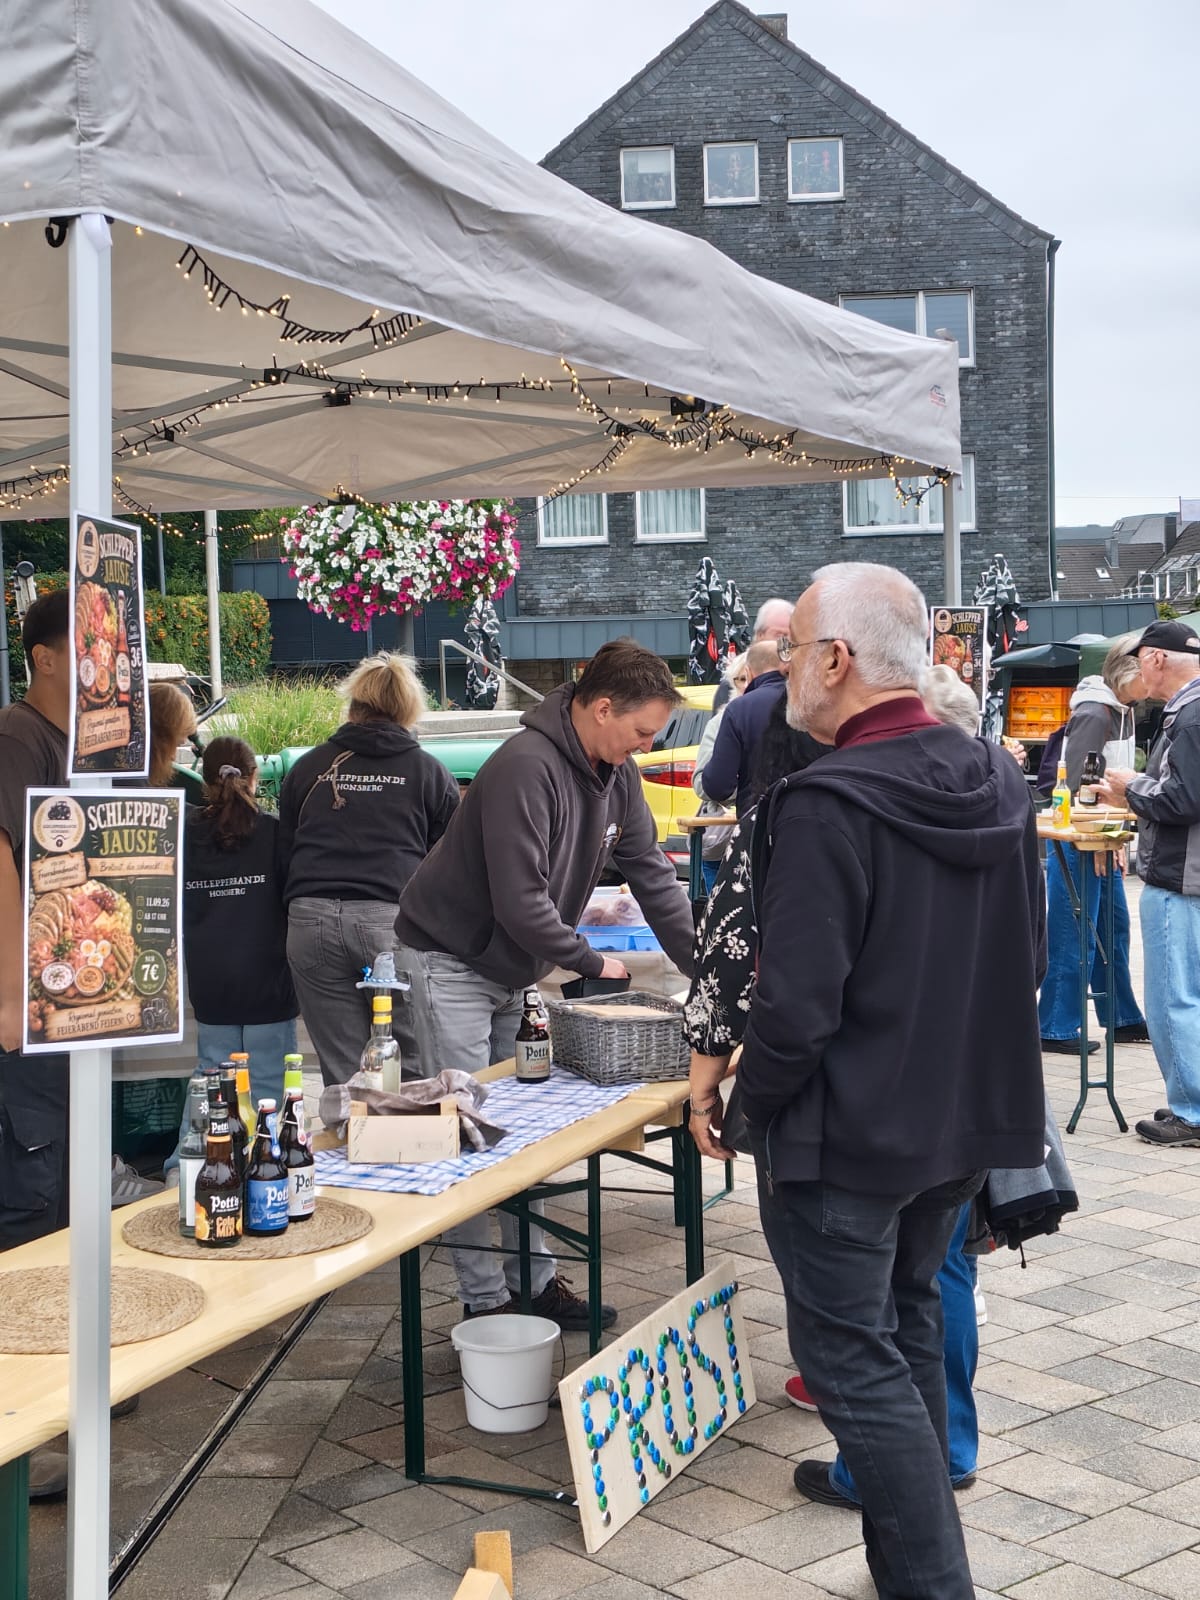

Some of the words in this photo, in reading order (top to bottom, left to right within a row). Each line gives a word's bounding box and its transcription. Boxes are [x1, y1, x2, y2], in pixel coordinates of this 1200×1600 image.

[104, 560, 131, 586] JAUSE
[956, 623, 977, 633] JAUSE
[317, 774, 407, 785] SHEPPERBANDE
[337, 783, 384, 792] HONSBERG
[87, 801, 174, 831] SCHLEPPER-
[100, 829, 158, 856] JAUSE
[185, 875, 266, 890] SCHLEPPERBANDE
[141, 963, 159, 982] 7€
[57, 1021, 98, 1036] FEIERABEND
[215, 1215, 235, 1226] Cola
[216, 1224, 235, 1238] MIX
[580, 1280, 739, 1527] PROST
